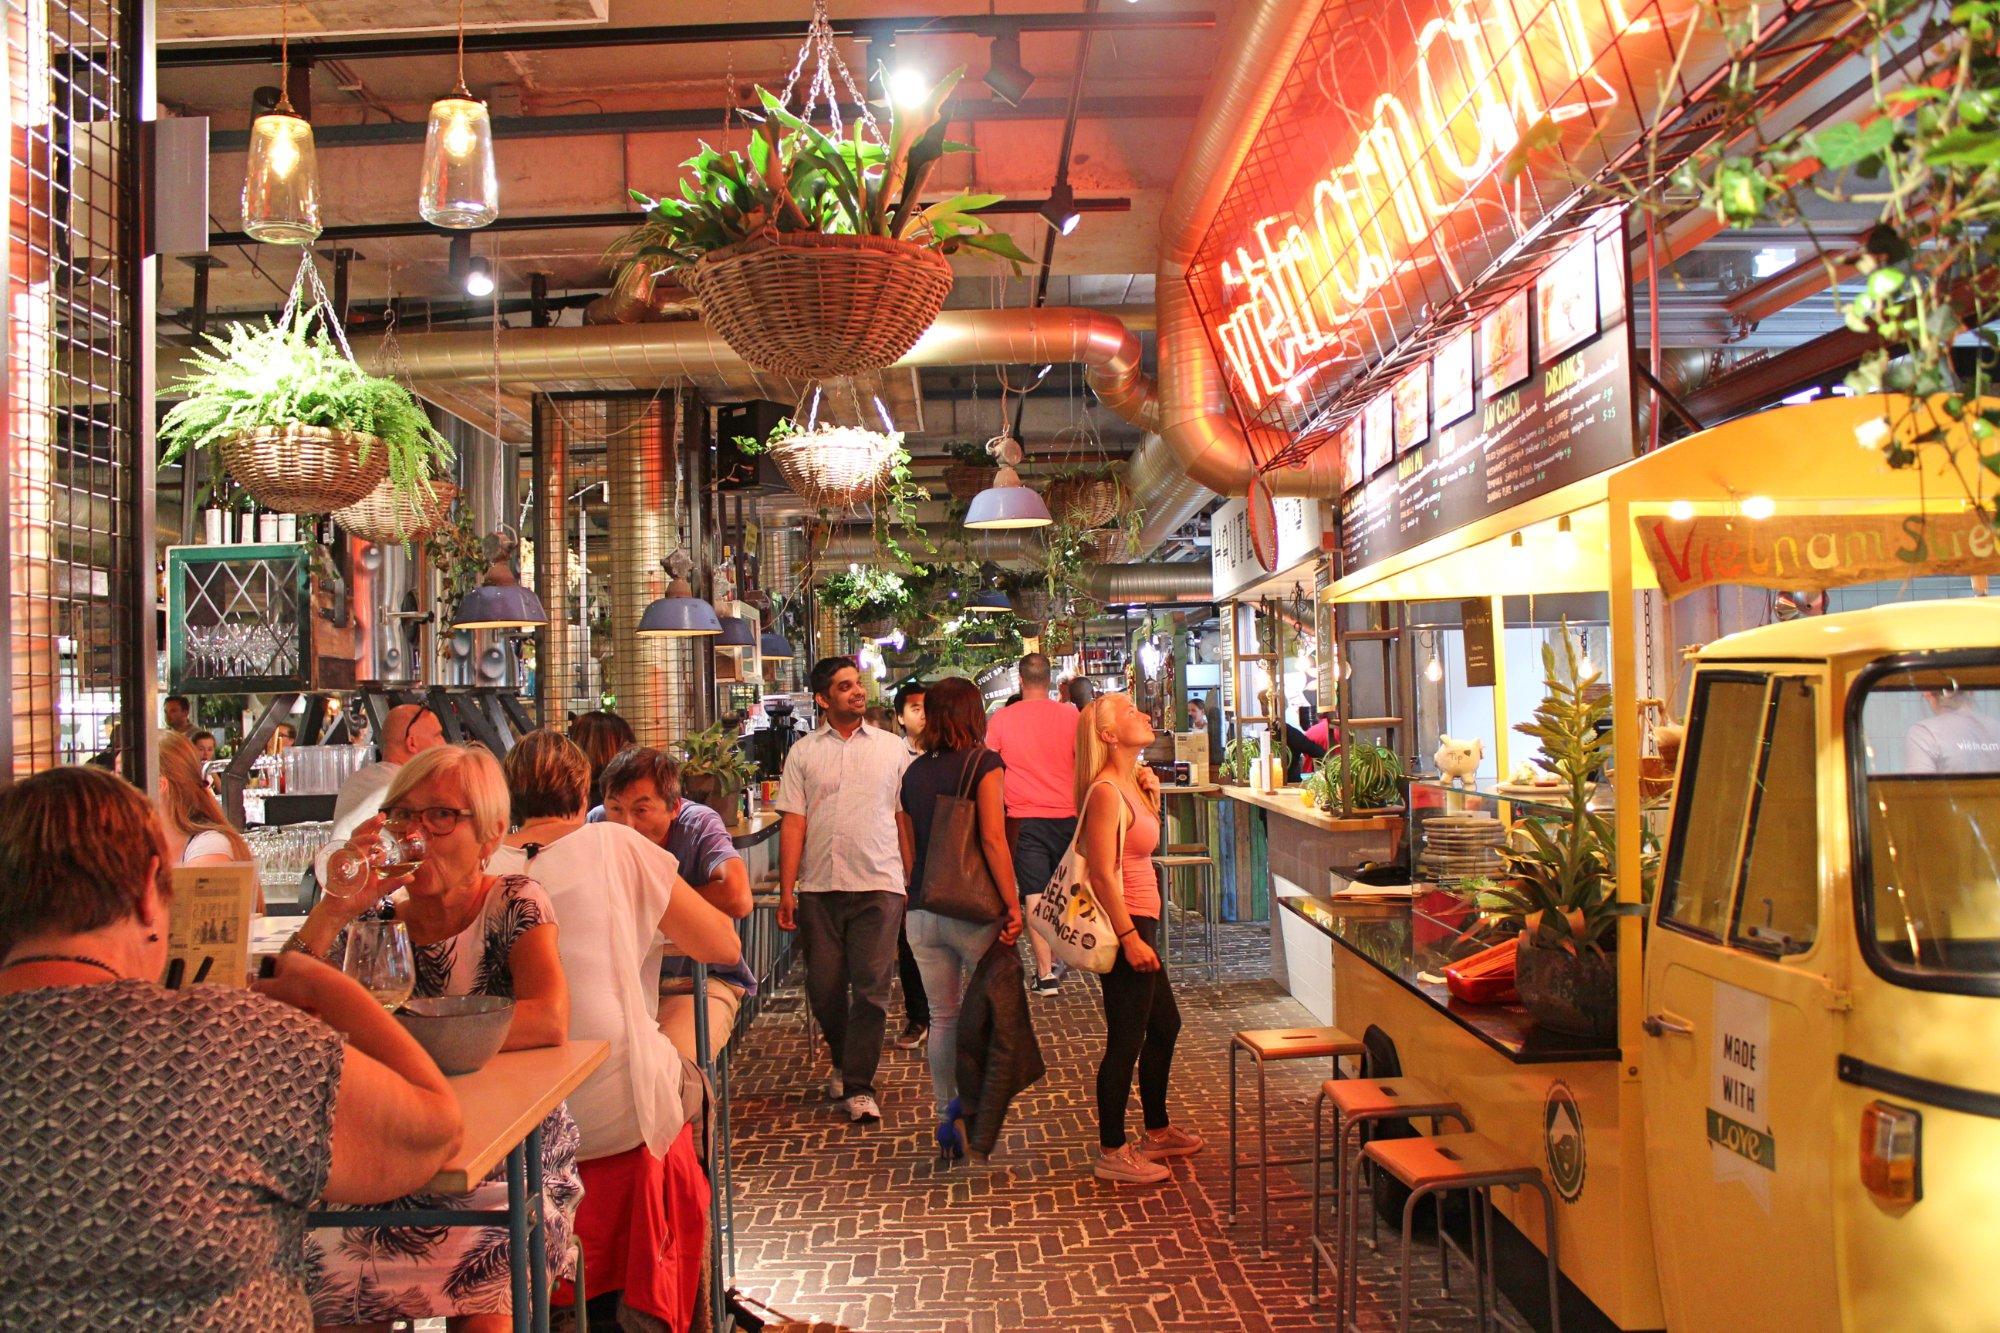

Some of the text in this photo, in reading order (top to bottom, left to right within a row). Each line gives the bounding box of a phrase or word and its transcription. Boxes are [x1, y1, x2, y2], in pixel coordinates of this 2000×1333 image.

[1545, 352, 1585, 399] DRINKS
[1654, 515, 2000, 584] Vietnam Stre
[1032, 902, 1042, 917] A
[1042, 904, 1080, 946] CHANCE
[1723, 1033, 1756, 1072] MADE
[1723, 1075, 1755, 1114] WITH
